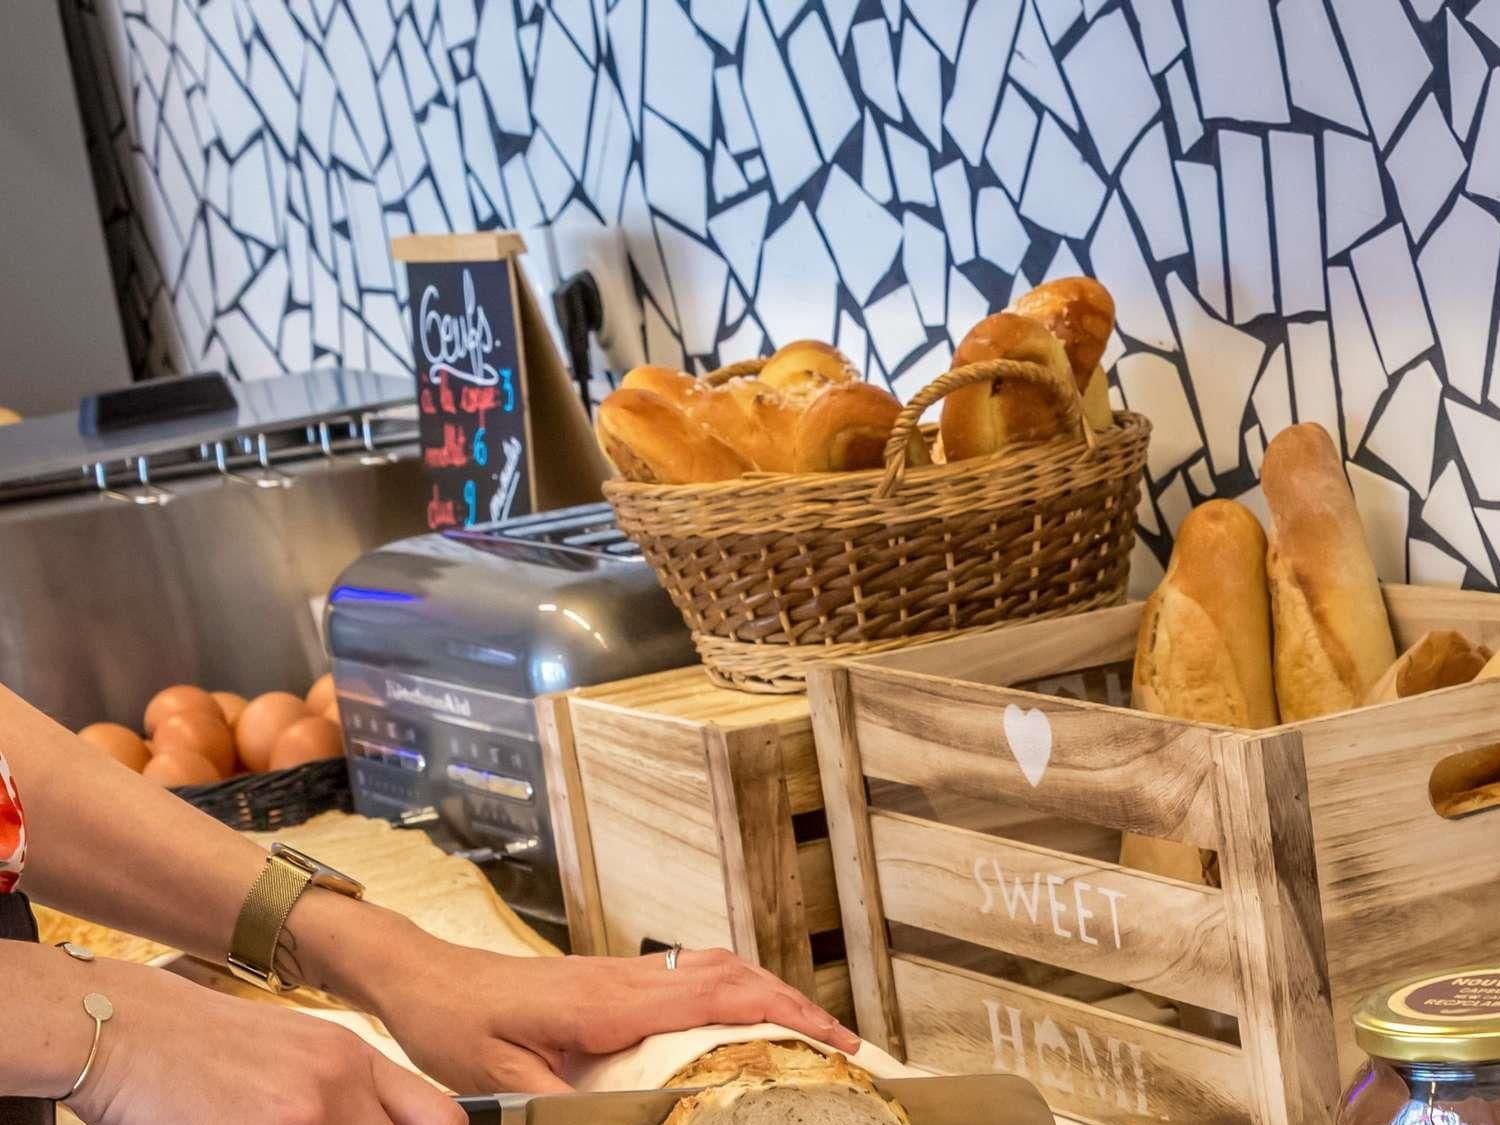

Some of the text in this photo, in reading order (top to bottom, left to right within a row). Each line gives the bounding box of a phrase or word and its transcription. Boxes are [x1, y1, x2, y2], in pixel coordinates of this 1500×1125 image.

[500, 368, 514, 413] 3
[473, 427, 488, 466] 6
[974, 856, 1127, 950] SWEET
